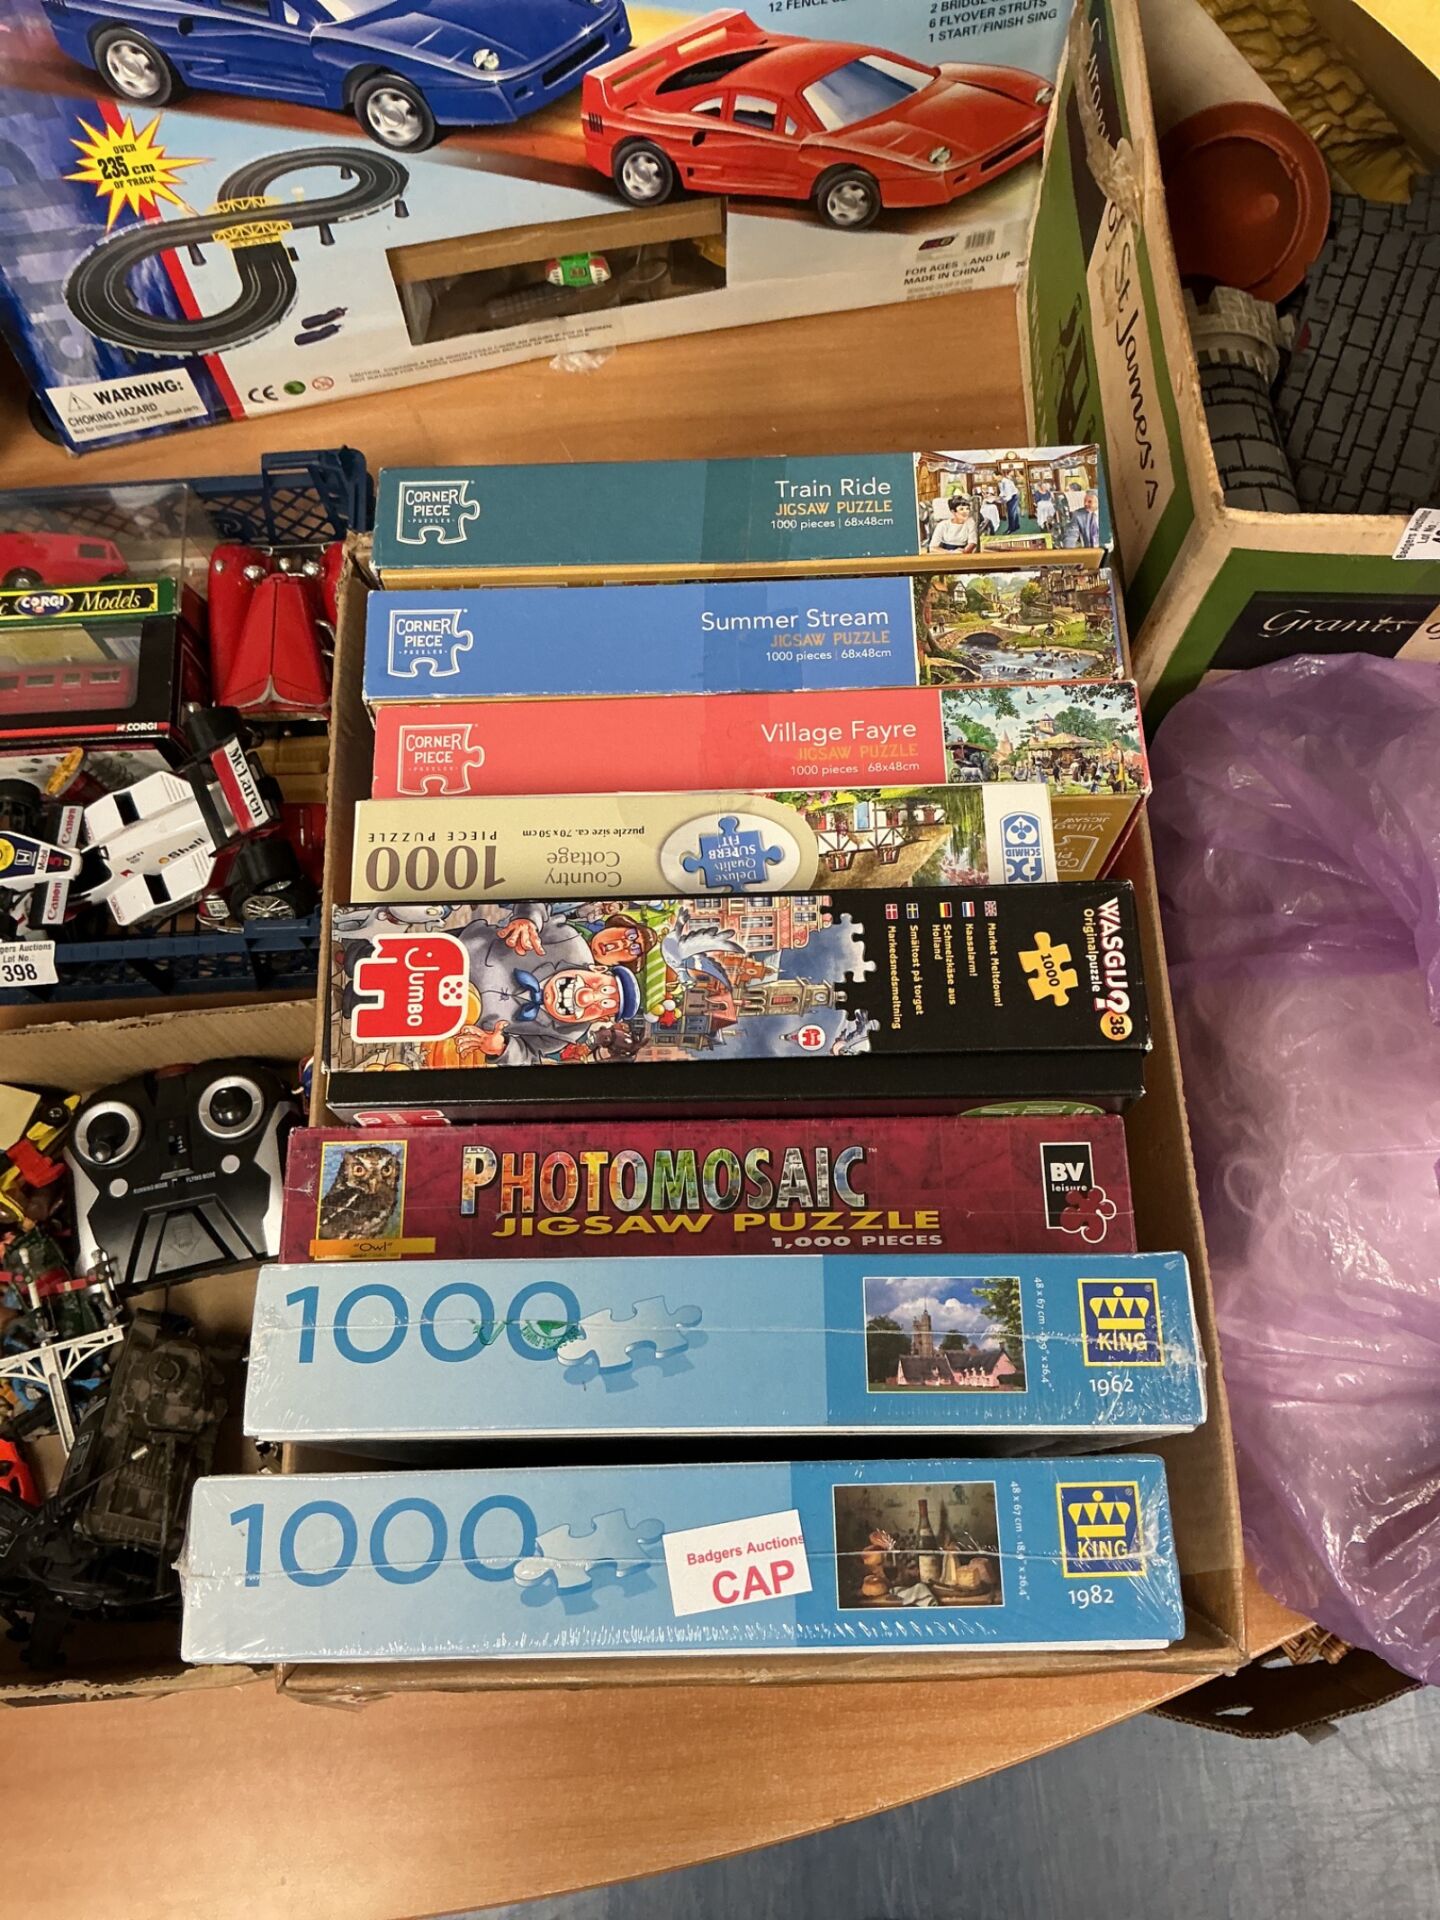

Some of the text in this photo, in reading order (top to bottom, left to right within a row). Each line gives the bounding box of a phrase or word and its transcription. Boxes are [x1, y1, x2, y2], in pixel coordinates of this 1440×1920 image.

[769, 1, 782, 12] 12
[929, 0, 1047, 28] 6 FLYOVER STRUTS
[930, 3, 938, 14] 2
[929, 8, 1058, 43] 1 START/FINISH SING
[113, 143, 137, 154] OVER
[97, 155, 156, 180] 235 cm
[113, 175, 157, 190] OF TRACK
[905, 251, 1011, 276] FOR AGES AND UP
[903, 265, 986, 286] MADE IN CHINA
[1114, 241, 1131, 313] St
[93, 379, 184, 406] WARNING:
[67, 402, 158, 427] CHOKING HAZARD
[405, 488, 459, 506] CORNER
[775, 477, 892, 498] Train Ride
[413, 505, 451, 517] PIECE
[775, 500, 893, 516] JIGSAW PUZZLE
[771, 516, 894, 530] 1000 pieces 68x48cm
[20, 595, 65, 608] CORGI
[79, 589, 142, 612] Models
[396, 618, 452, 636] CORNER
[701, 608, 889, 631] Summer Stream
[1257, 609, 1419, 639] Grants
[404, 634, 443, 648] PIECE
[771, 630, 891, 647] JIGSAW PUZZLE
[766, 648, 892, 662] 1000 pieces 68x48cm
[126, 722, 157, 733] CORGI
[761, 720, 918, 747] Village Fayre
[406, 733, 462, 752] CORNER
[796, 743, 919, 761] JIGSAW PUZZLE
[414, 751, 454, 764] PIECE
[790, 761, 920, 776] 1000 pieces 68x48cm
[229, 746, 263, 818] McLaren
[61, 808, 77, 845] Canon
[592, 828, 611, 837] size
[612, 826, 645, 838] puzzle
[1054, 820, 1104, 832] Villag
[367, 830, 498, 843] PIECE PUZZLE
[167, 837, 206, 859] Shell
[546, 847, 621, 868] Cottage
[708, 844, 757, 860] SUPERB
[1005, 848, 1042, 857] SCHMID
[37, 849, 49, 871] Mobil
[365, 844, 506, 892] 1000
[714, 858, 757, 875] Quality
[544, 868, 622, 888] Country
[715, 869, 757, 883] Deluxe
[47, 882, 63, 921] Canon
[0, 943, 52, 955] gers Auctions
[932, 924, 943, 960] Holland
[965, 923, 978, 977] Kaasalarm!
[3, 955, 16, 963] Lot
[943, 923, 957, 1006] Schmelzkäse aus
[987, 922, 1004, 1007] Market Meltdown!
[1, 963, 38, 983] 398
[887, 925, 903, 1030] Markedsnedsmeltning
[909, 924, 925, 1016] Smältost på torget
[1040, 953, 1061, 988] 1000
[1109, 1016, 1126, 1036] 38
[460, 1144, 867, 1217] PHOTOMOSAIC
[1049, 1162, 1085, 1182] BV
[1051, 1183, 1088, 1193] leisure
[491, 1210, 940, 1238] JIGSAW PUZZLE
[353, 1241, 393, 1252] "Owl"
[772, 1234, 943, 1250] 1,000 PIECES
[1034, 1276, 1045, 1288] 48
[1035, 1298, 1046, 1309] 67
[285, 1280, 581, 1365] 1000
[1037, 1310, 1046, 1325] cm
[1097, 1331, 1148, 1352] KING
[1088, 1374, 1135, 1397] 1962
[1010, 1480, 1021, 1494] 48
[1012, 1504, 1023, 1516] 67
[1014, 1517, 1023, 1532] cm
[229, 1493, 538, 1588] 1000
[686, 1534, 805, 1566] Badgers Auctions
[1077, 1540, 1128, 1560] KING
[712, 1559, 796, 1605] CAP
[1068, 1584, 1114, 1609] 1982
